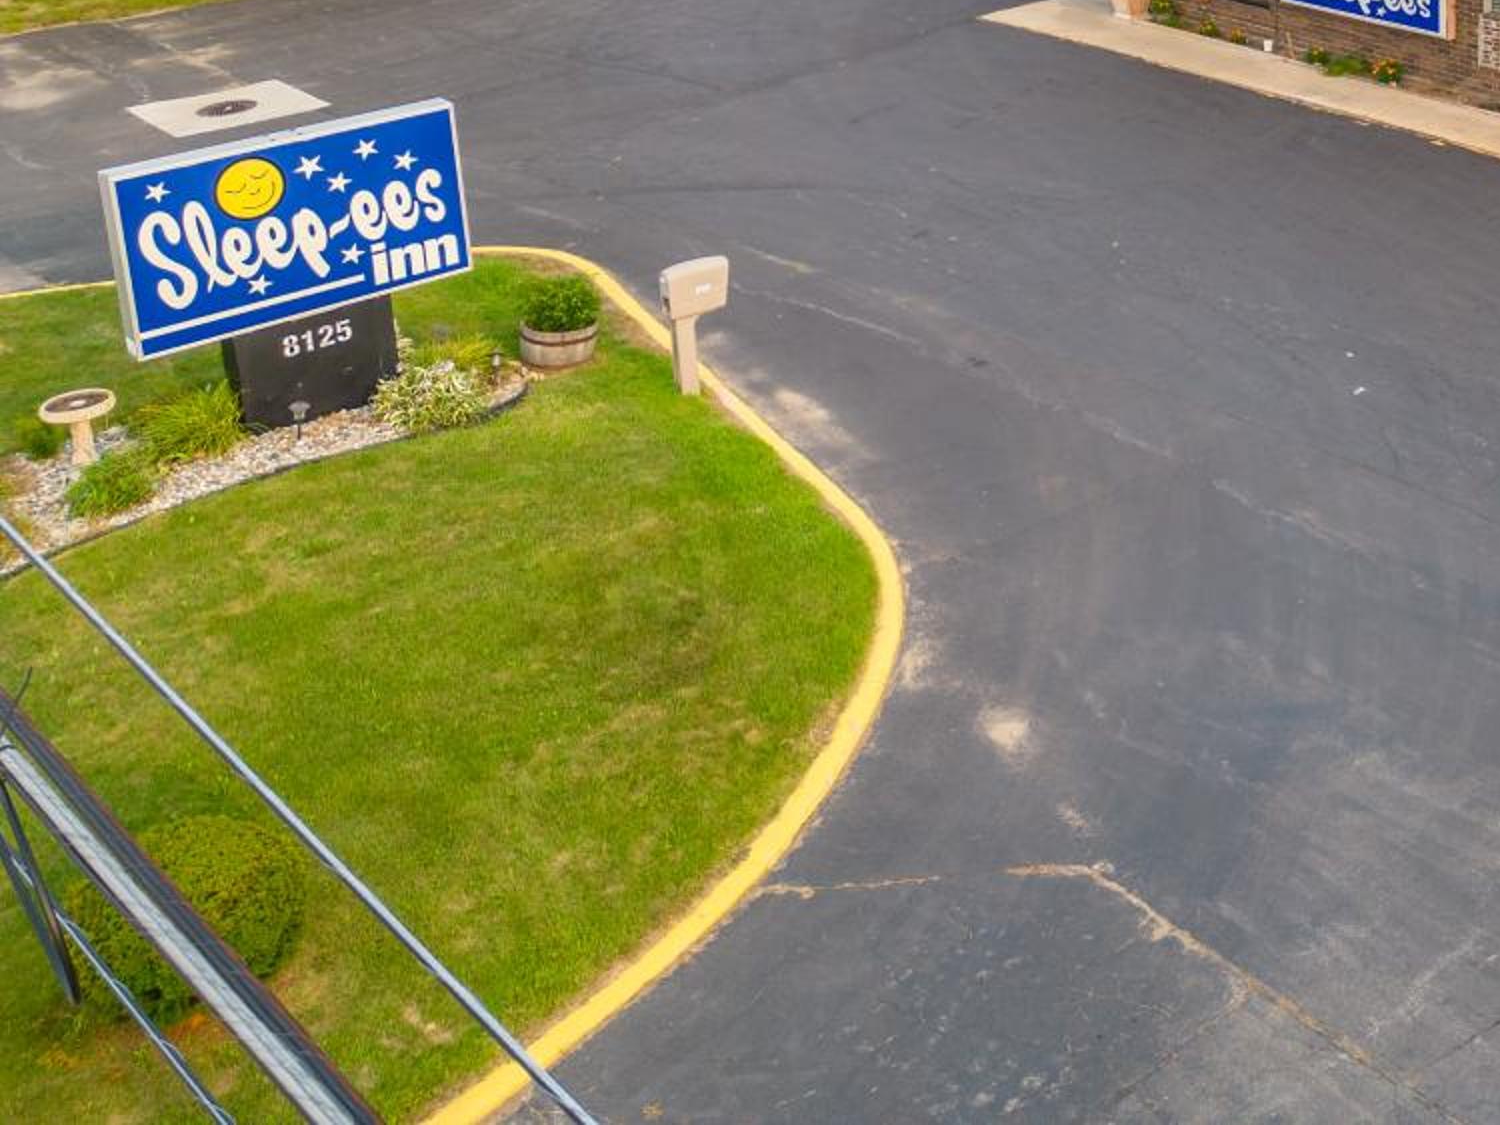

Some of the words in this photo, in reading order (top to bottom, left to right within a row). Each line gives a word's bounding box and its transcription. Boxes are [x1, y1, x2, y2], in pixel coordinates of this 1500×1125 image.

[138, 168, 447, 310] Sleep-ees
[371, 233, 460, 286] inn
[283, 319, 352, 357] 8125
